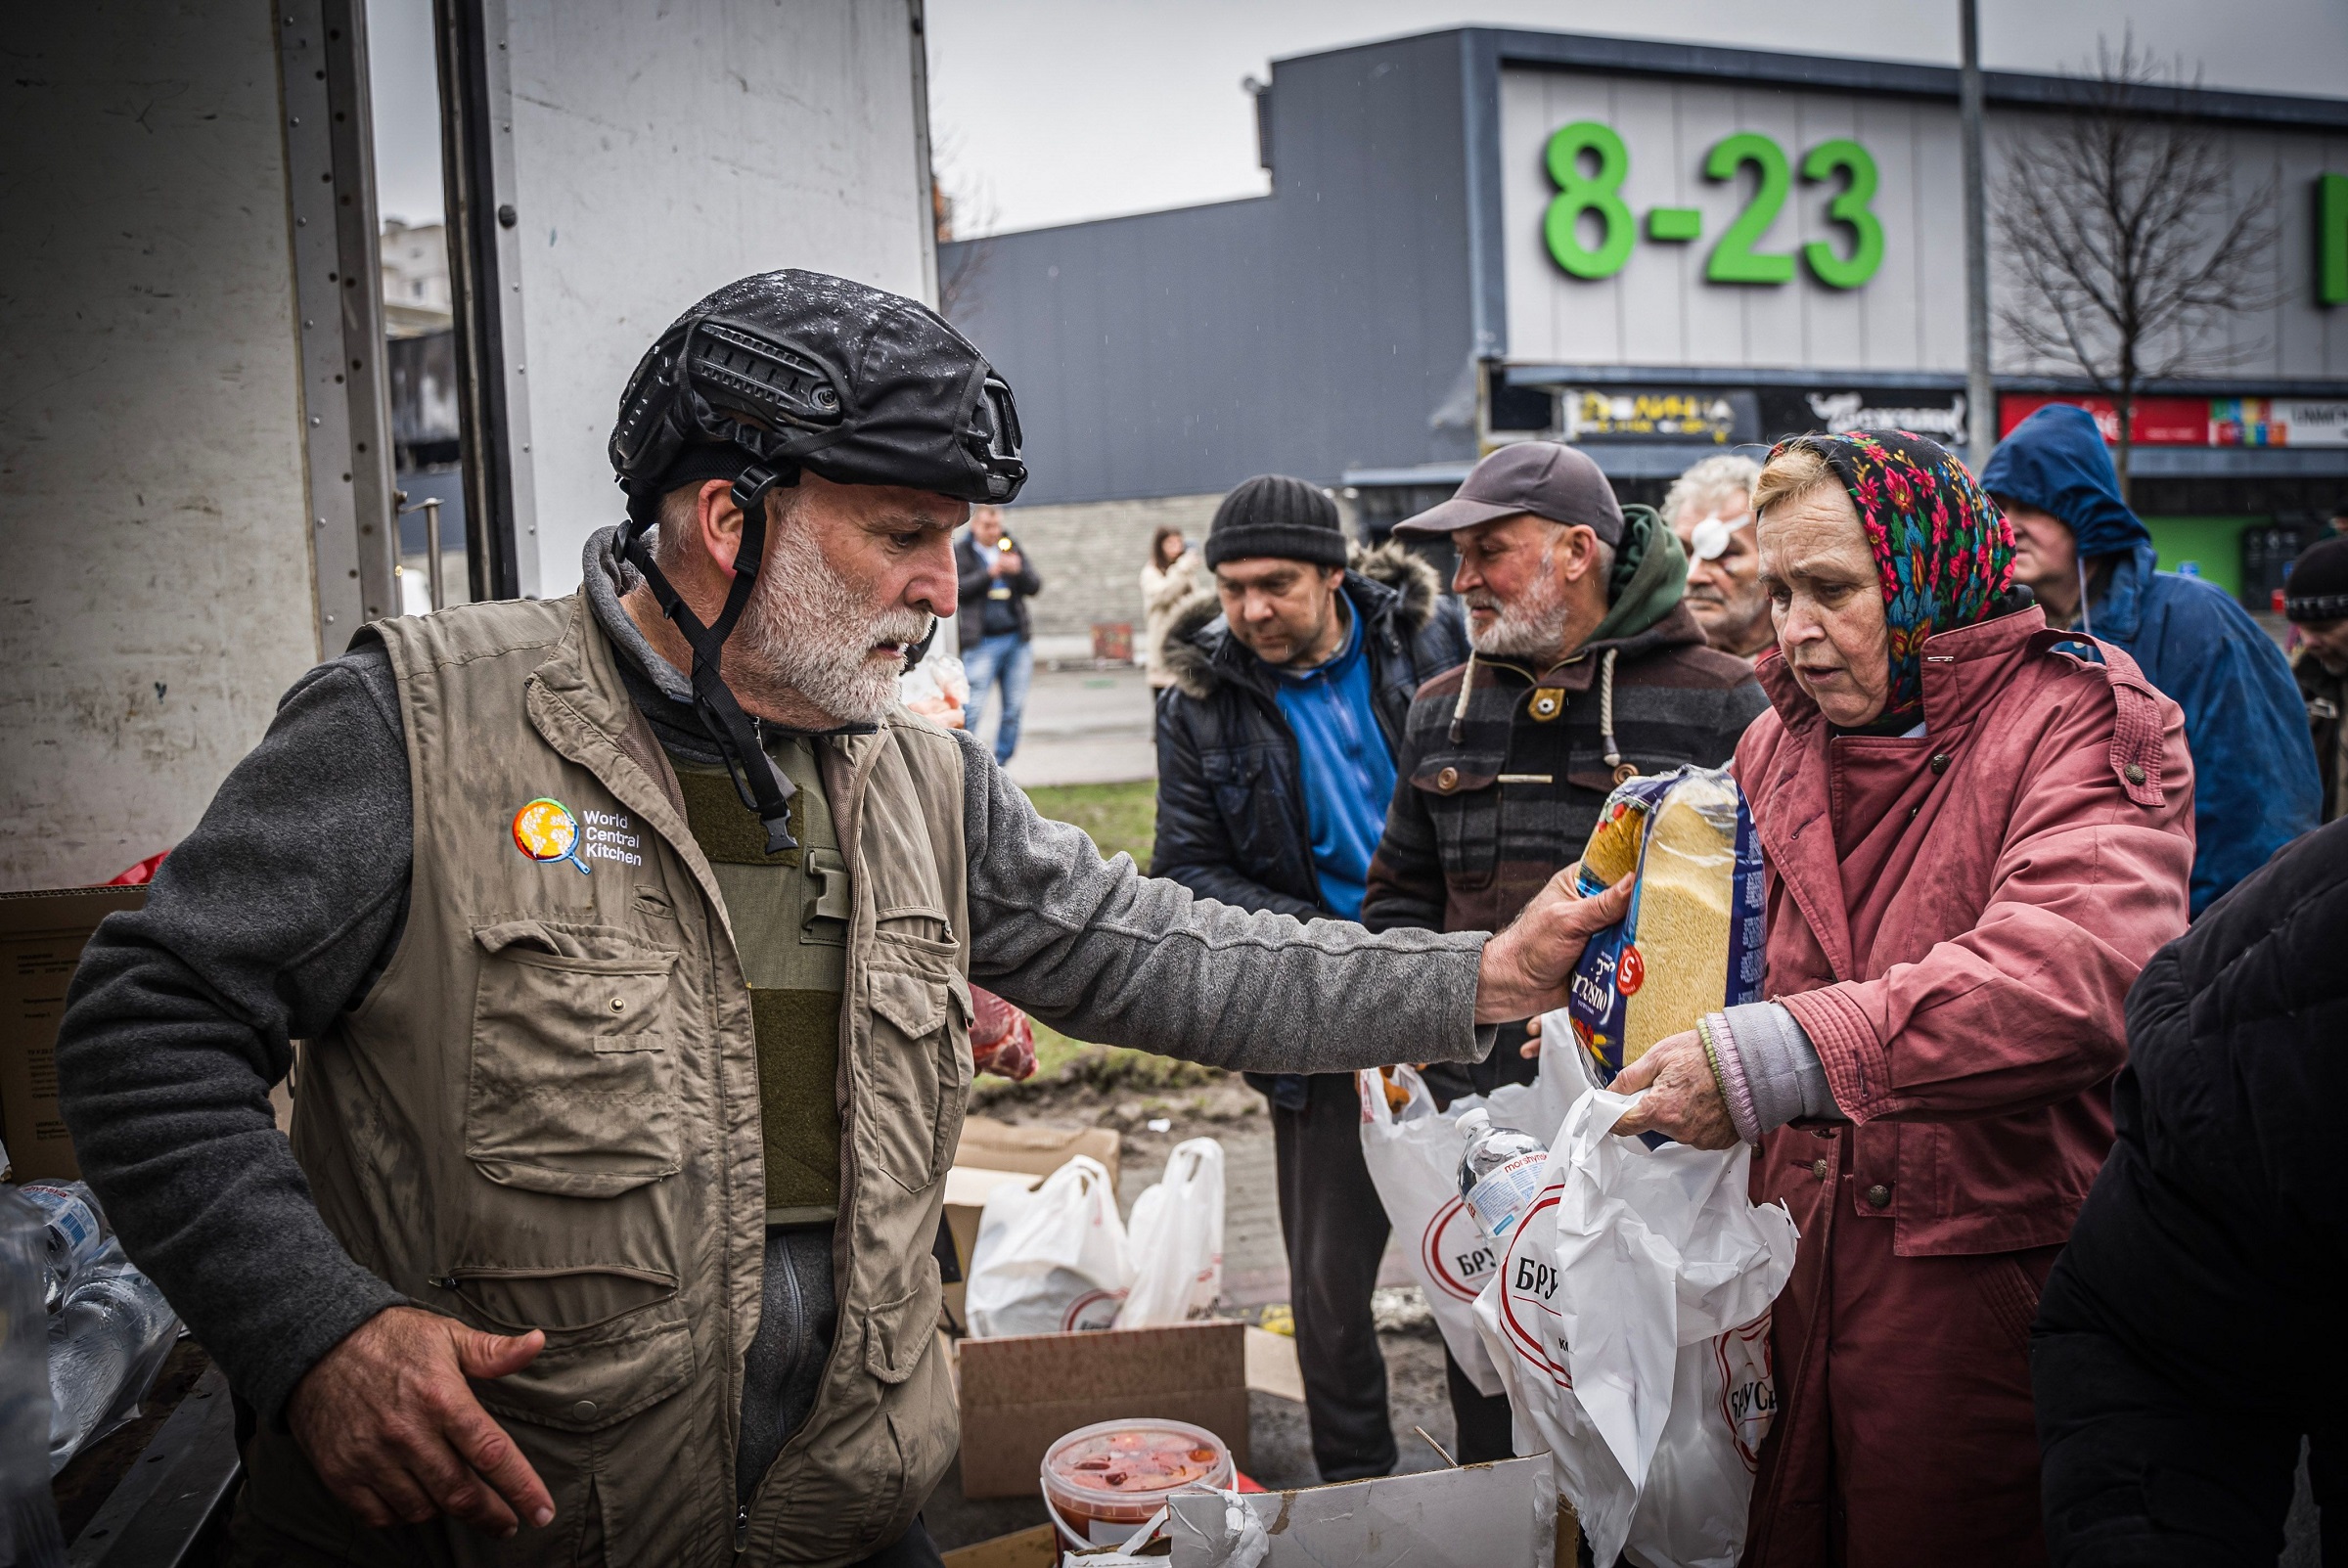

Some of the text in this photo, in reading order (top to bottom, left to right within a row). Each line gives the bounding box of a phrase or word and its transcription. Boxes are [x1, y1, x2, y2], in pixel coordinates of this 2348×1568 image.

[1544, 119, 1885, 291] 8-23
[583, 810, 628, 829] World
[586, 827, 640, 848] Central
[586, 842, 642, 867] Kitchen
